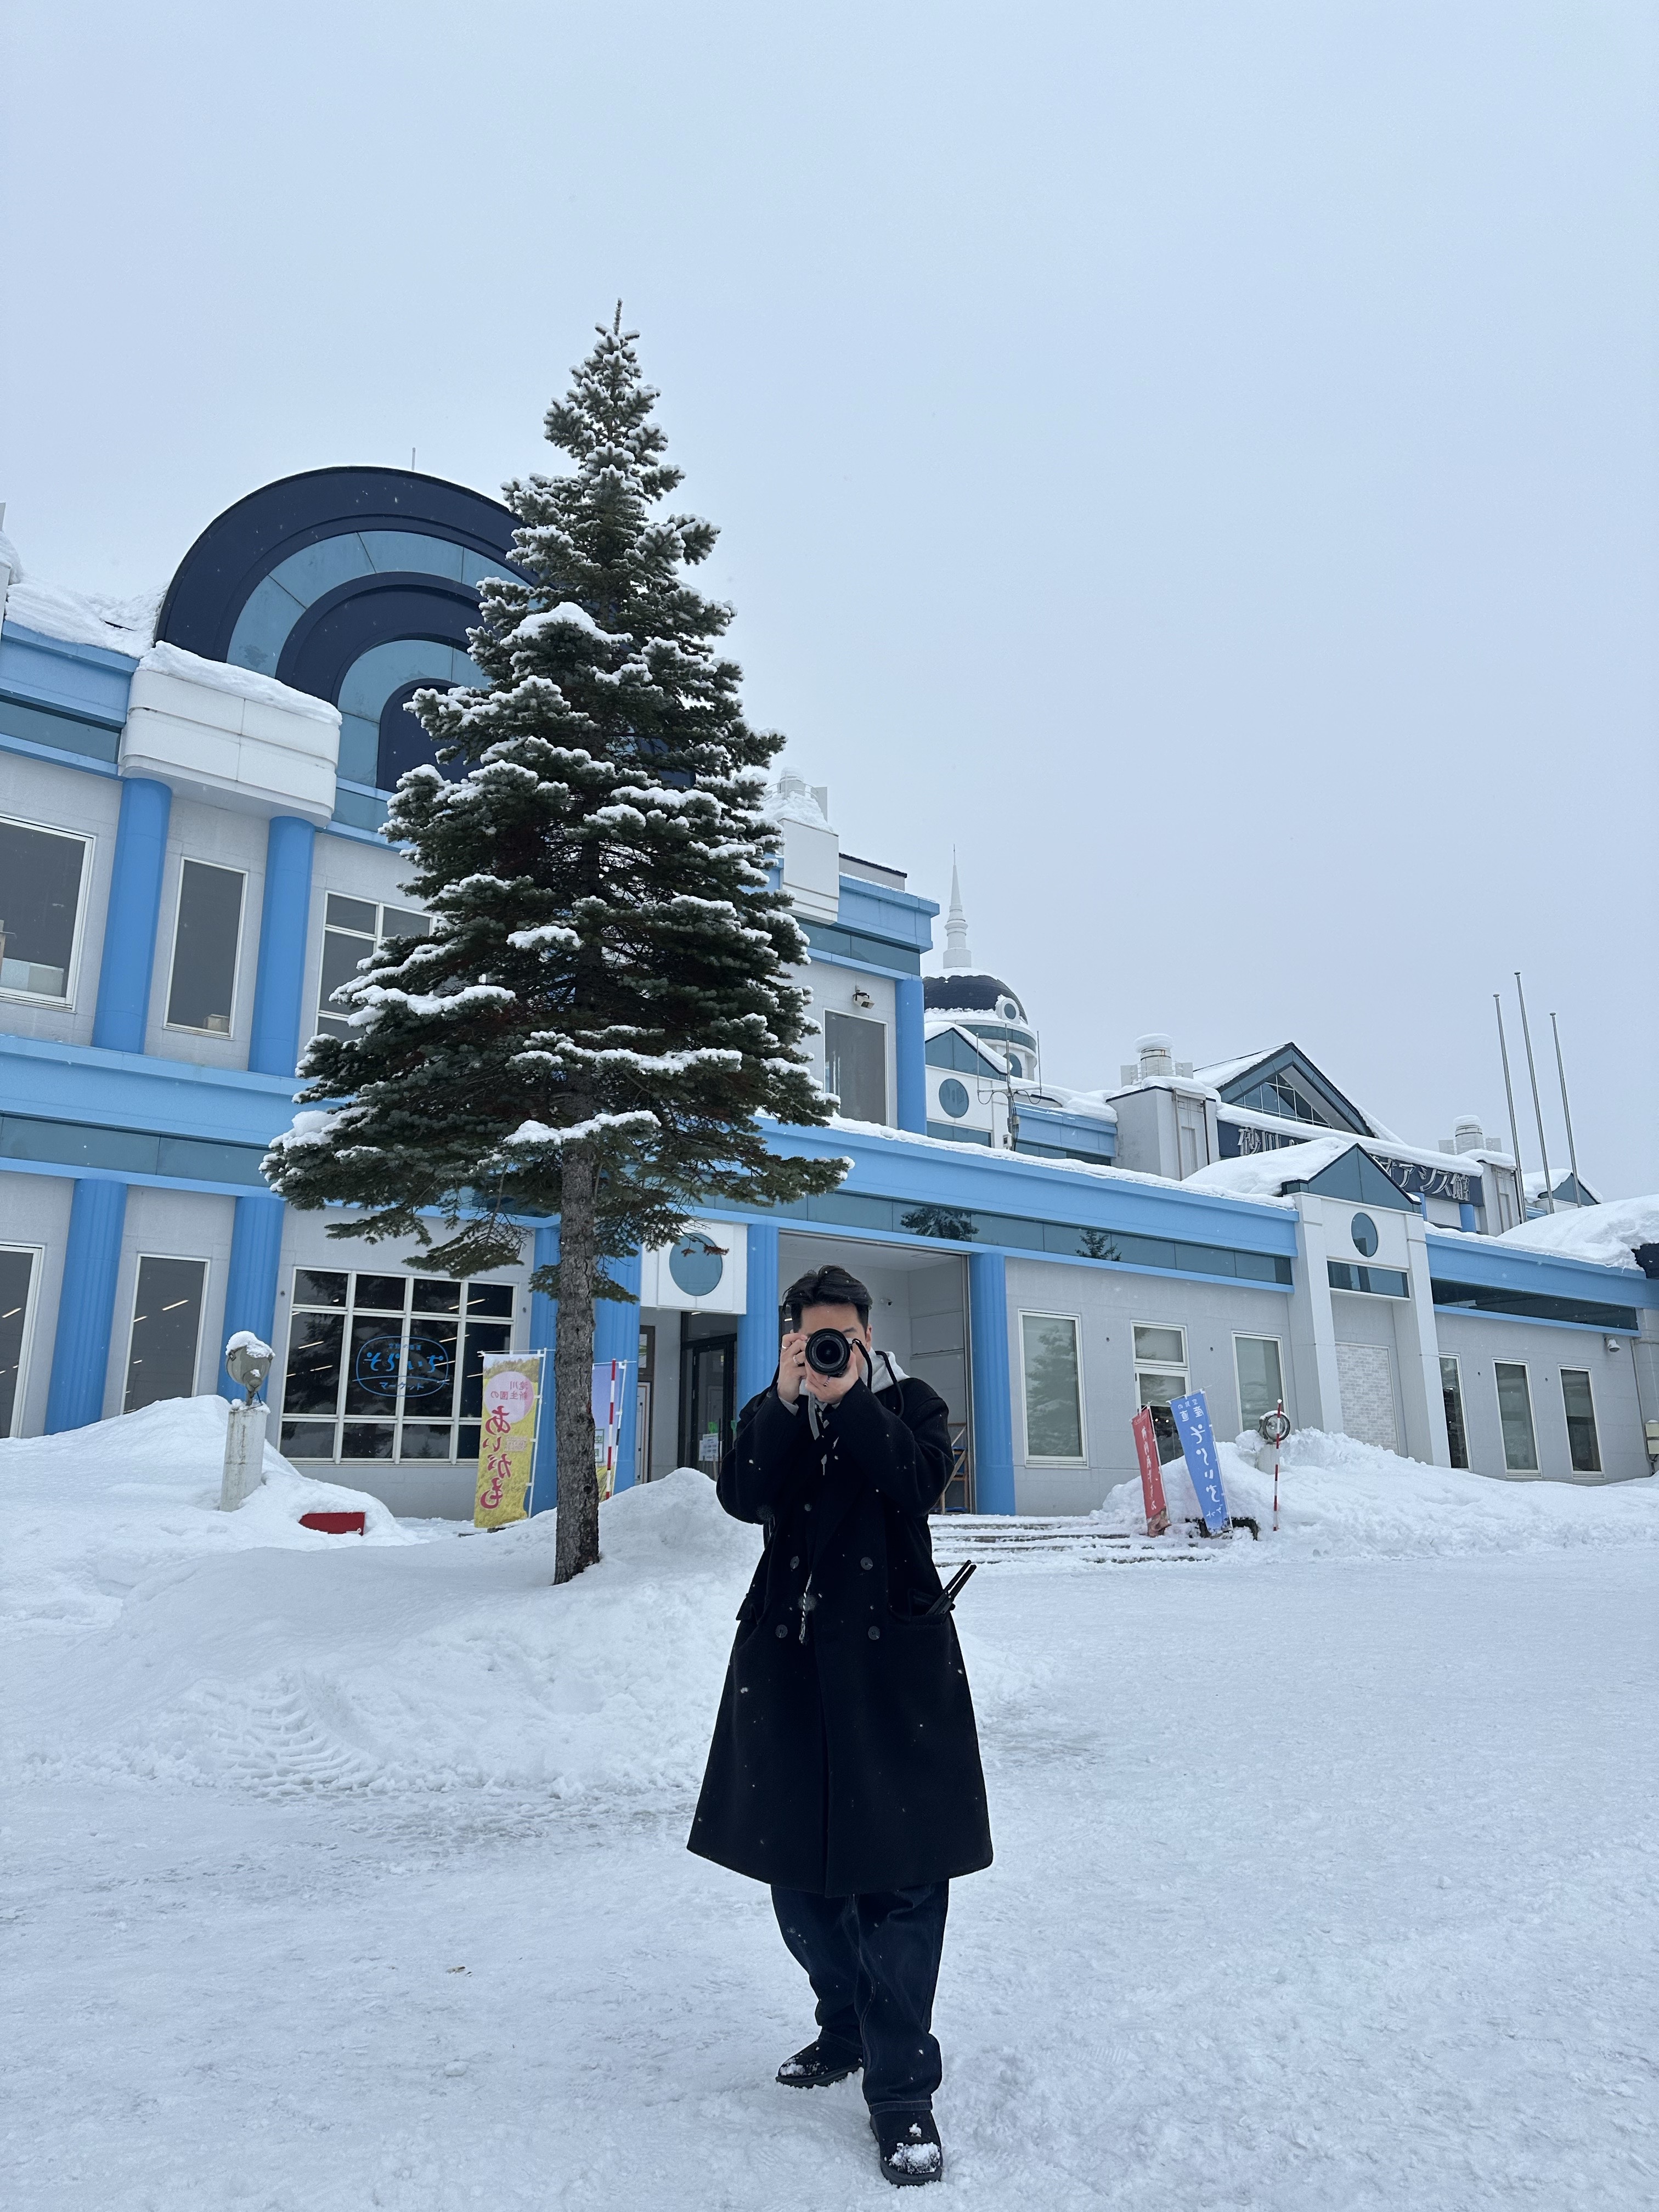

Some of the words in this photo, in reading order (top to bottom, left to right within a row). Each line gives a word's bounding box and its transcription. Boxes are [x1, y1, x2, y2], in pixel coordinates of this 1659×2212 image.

[1369, 1154, 1470, 1201] オアシス館
[379, 1382, 424, 1390] マーケット
